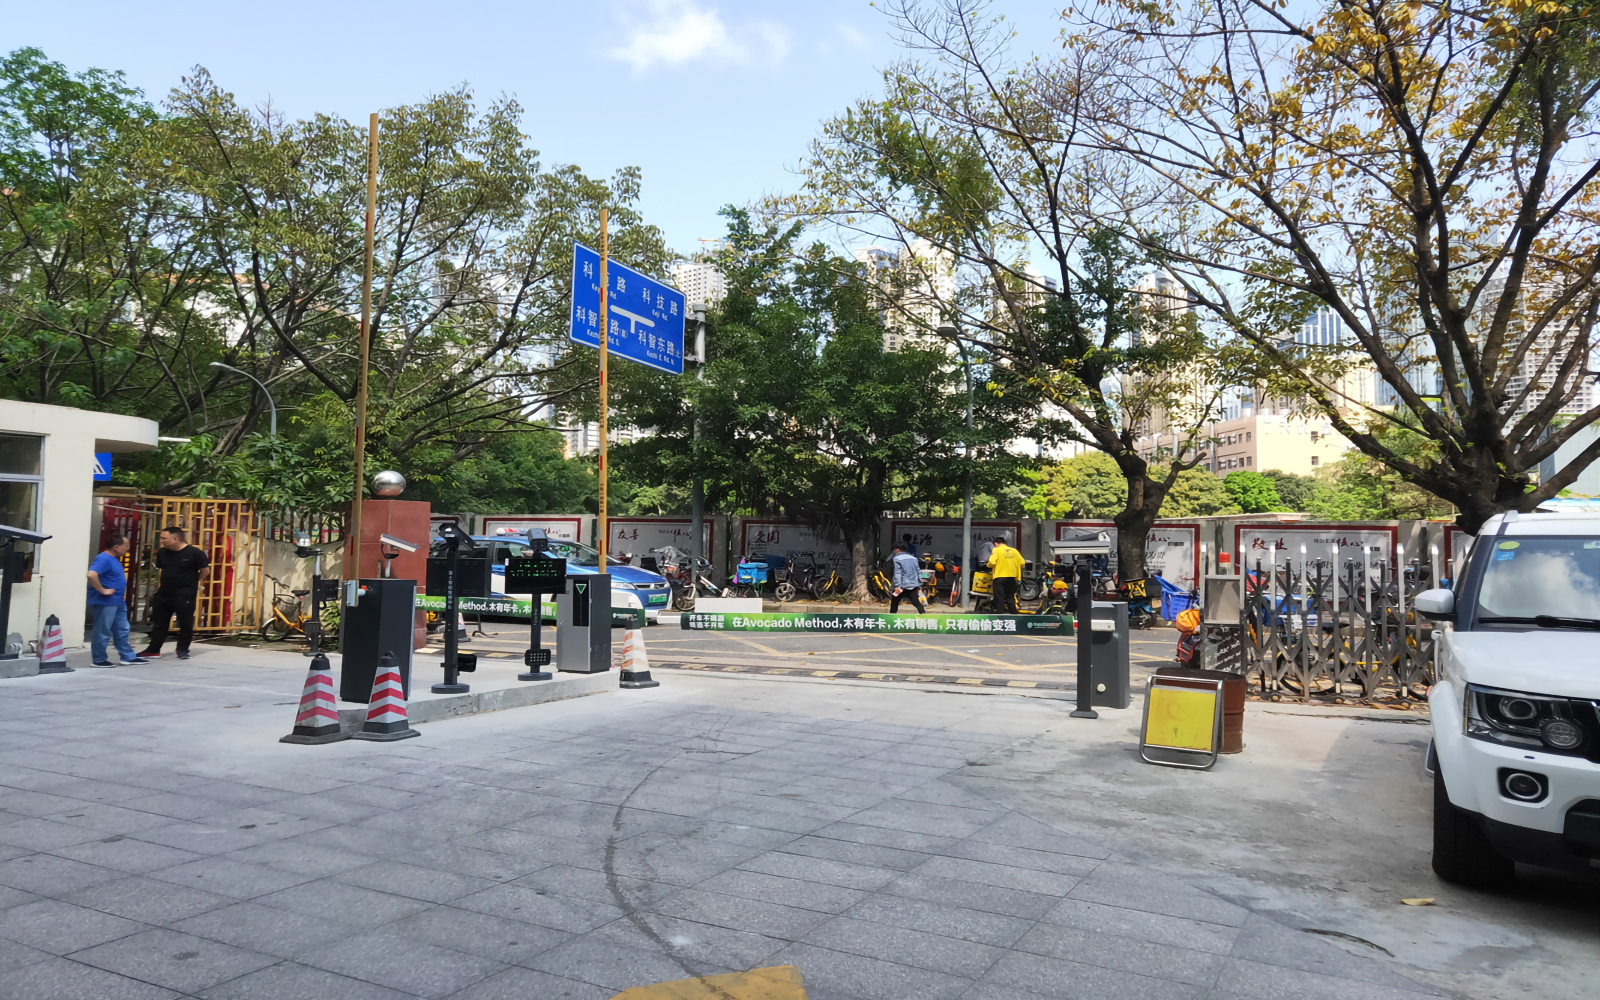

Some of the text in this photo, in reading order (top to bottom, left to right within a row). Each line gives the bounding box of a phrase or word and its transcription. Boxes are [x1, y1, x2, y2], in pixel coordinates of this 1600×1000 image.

[582, 261, 626, 293] 科路
[642, 287, 678, 316] 科技路
[732, 616, 792, 628] 在Avocado
